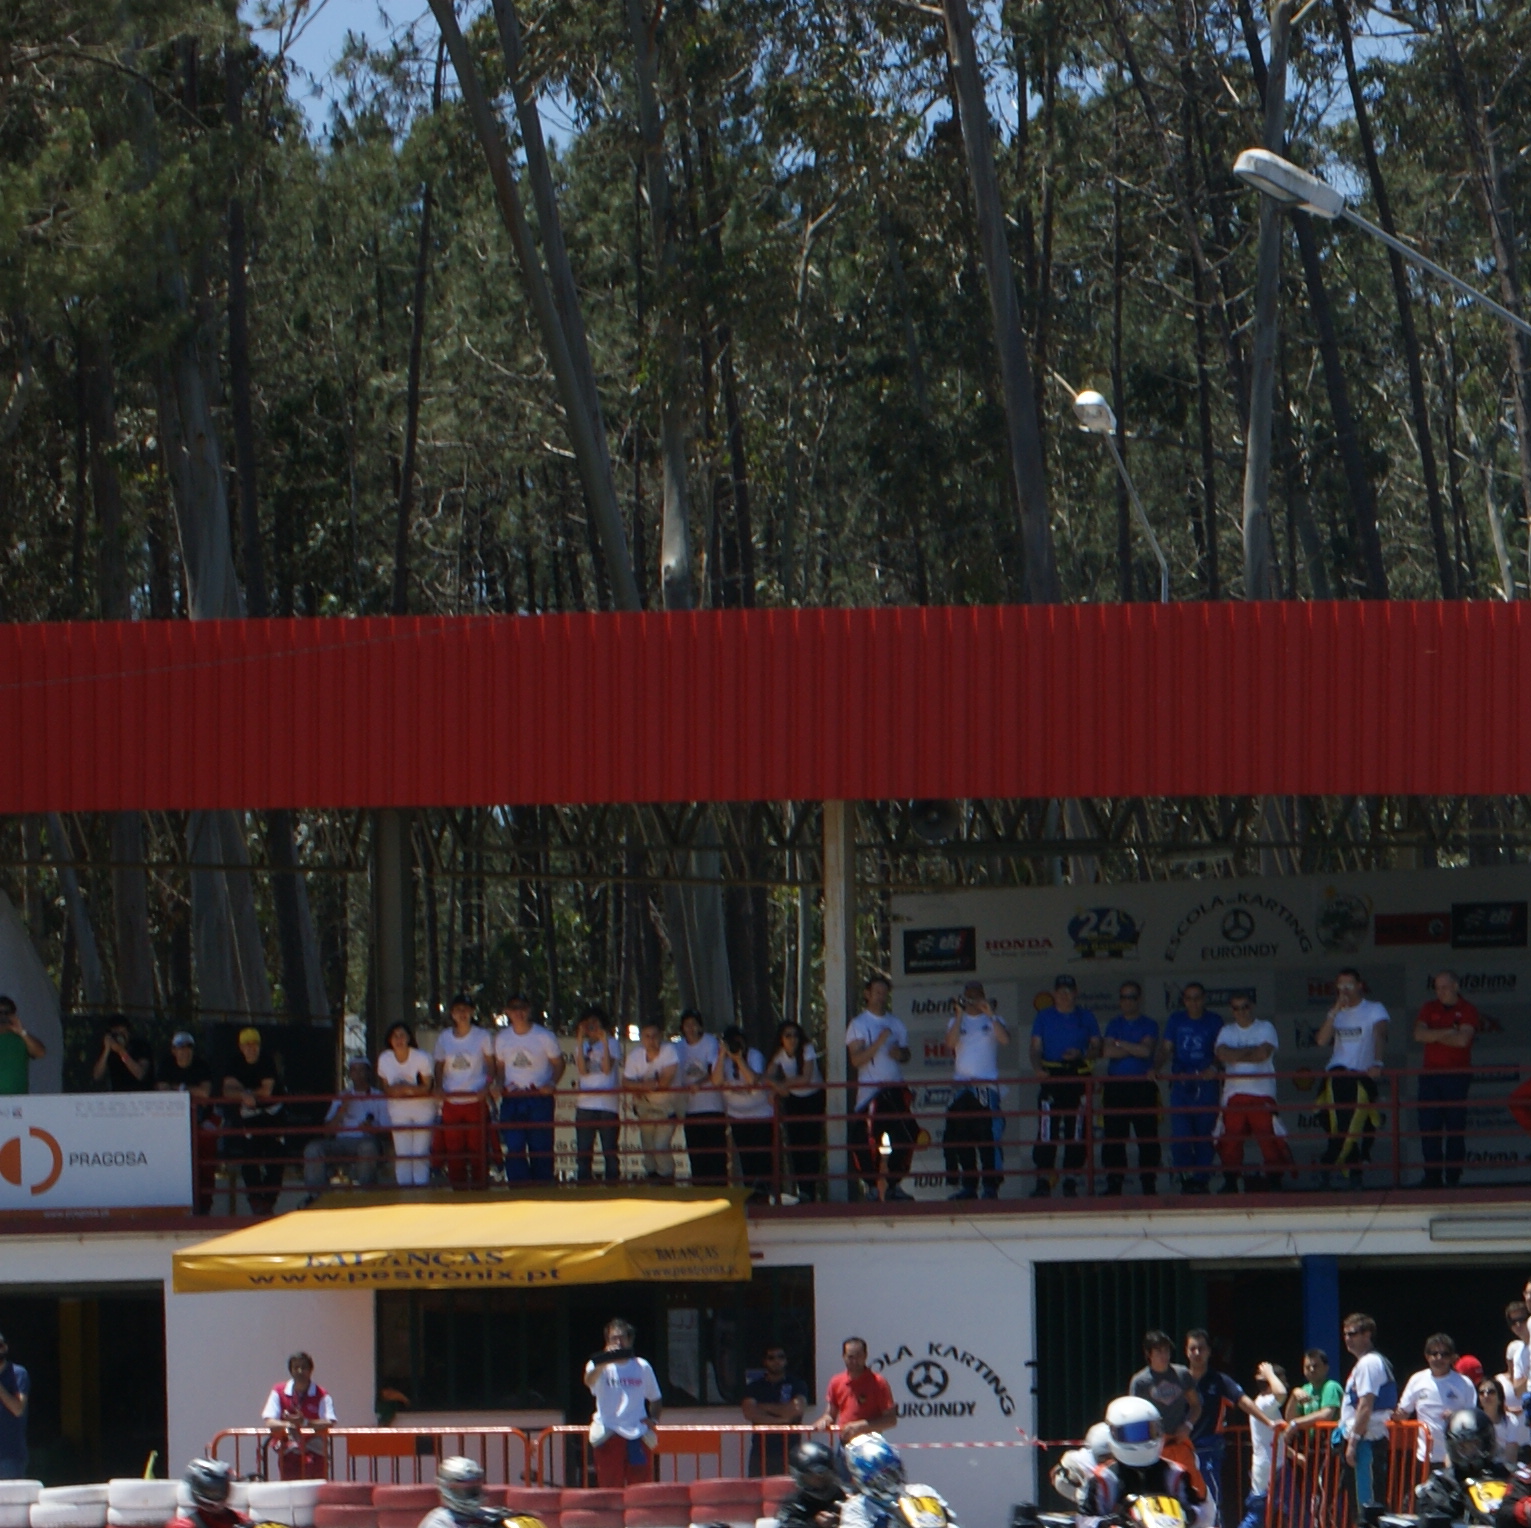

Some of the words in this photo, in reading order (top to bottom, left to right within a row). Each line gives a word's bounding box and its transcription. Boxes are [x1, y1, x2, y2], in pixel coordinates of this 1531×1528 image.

[1078, 909, 1121, 938] 24
[984, 937, 1054, 952] HONDA
[1201, 943, 1280, 961] EUROINDY
[69, 1151, 149, 1167] PRAGOSA
[929, 1341, 1016, 1416] KARTING
[895, 1401, 976, 1418] UROINDY
